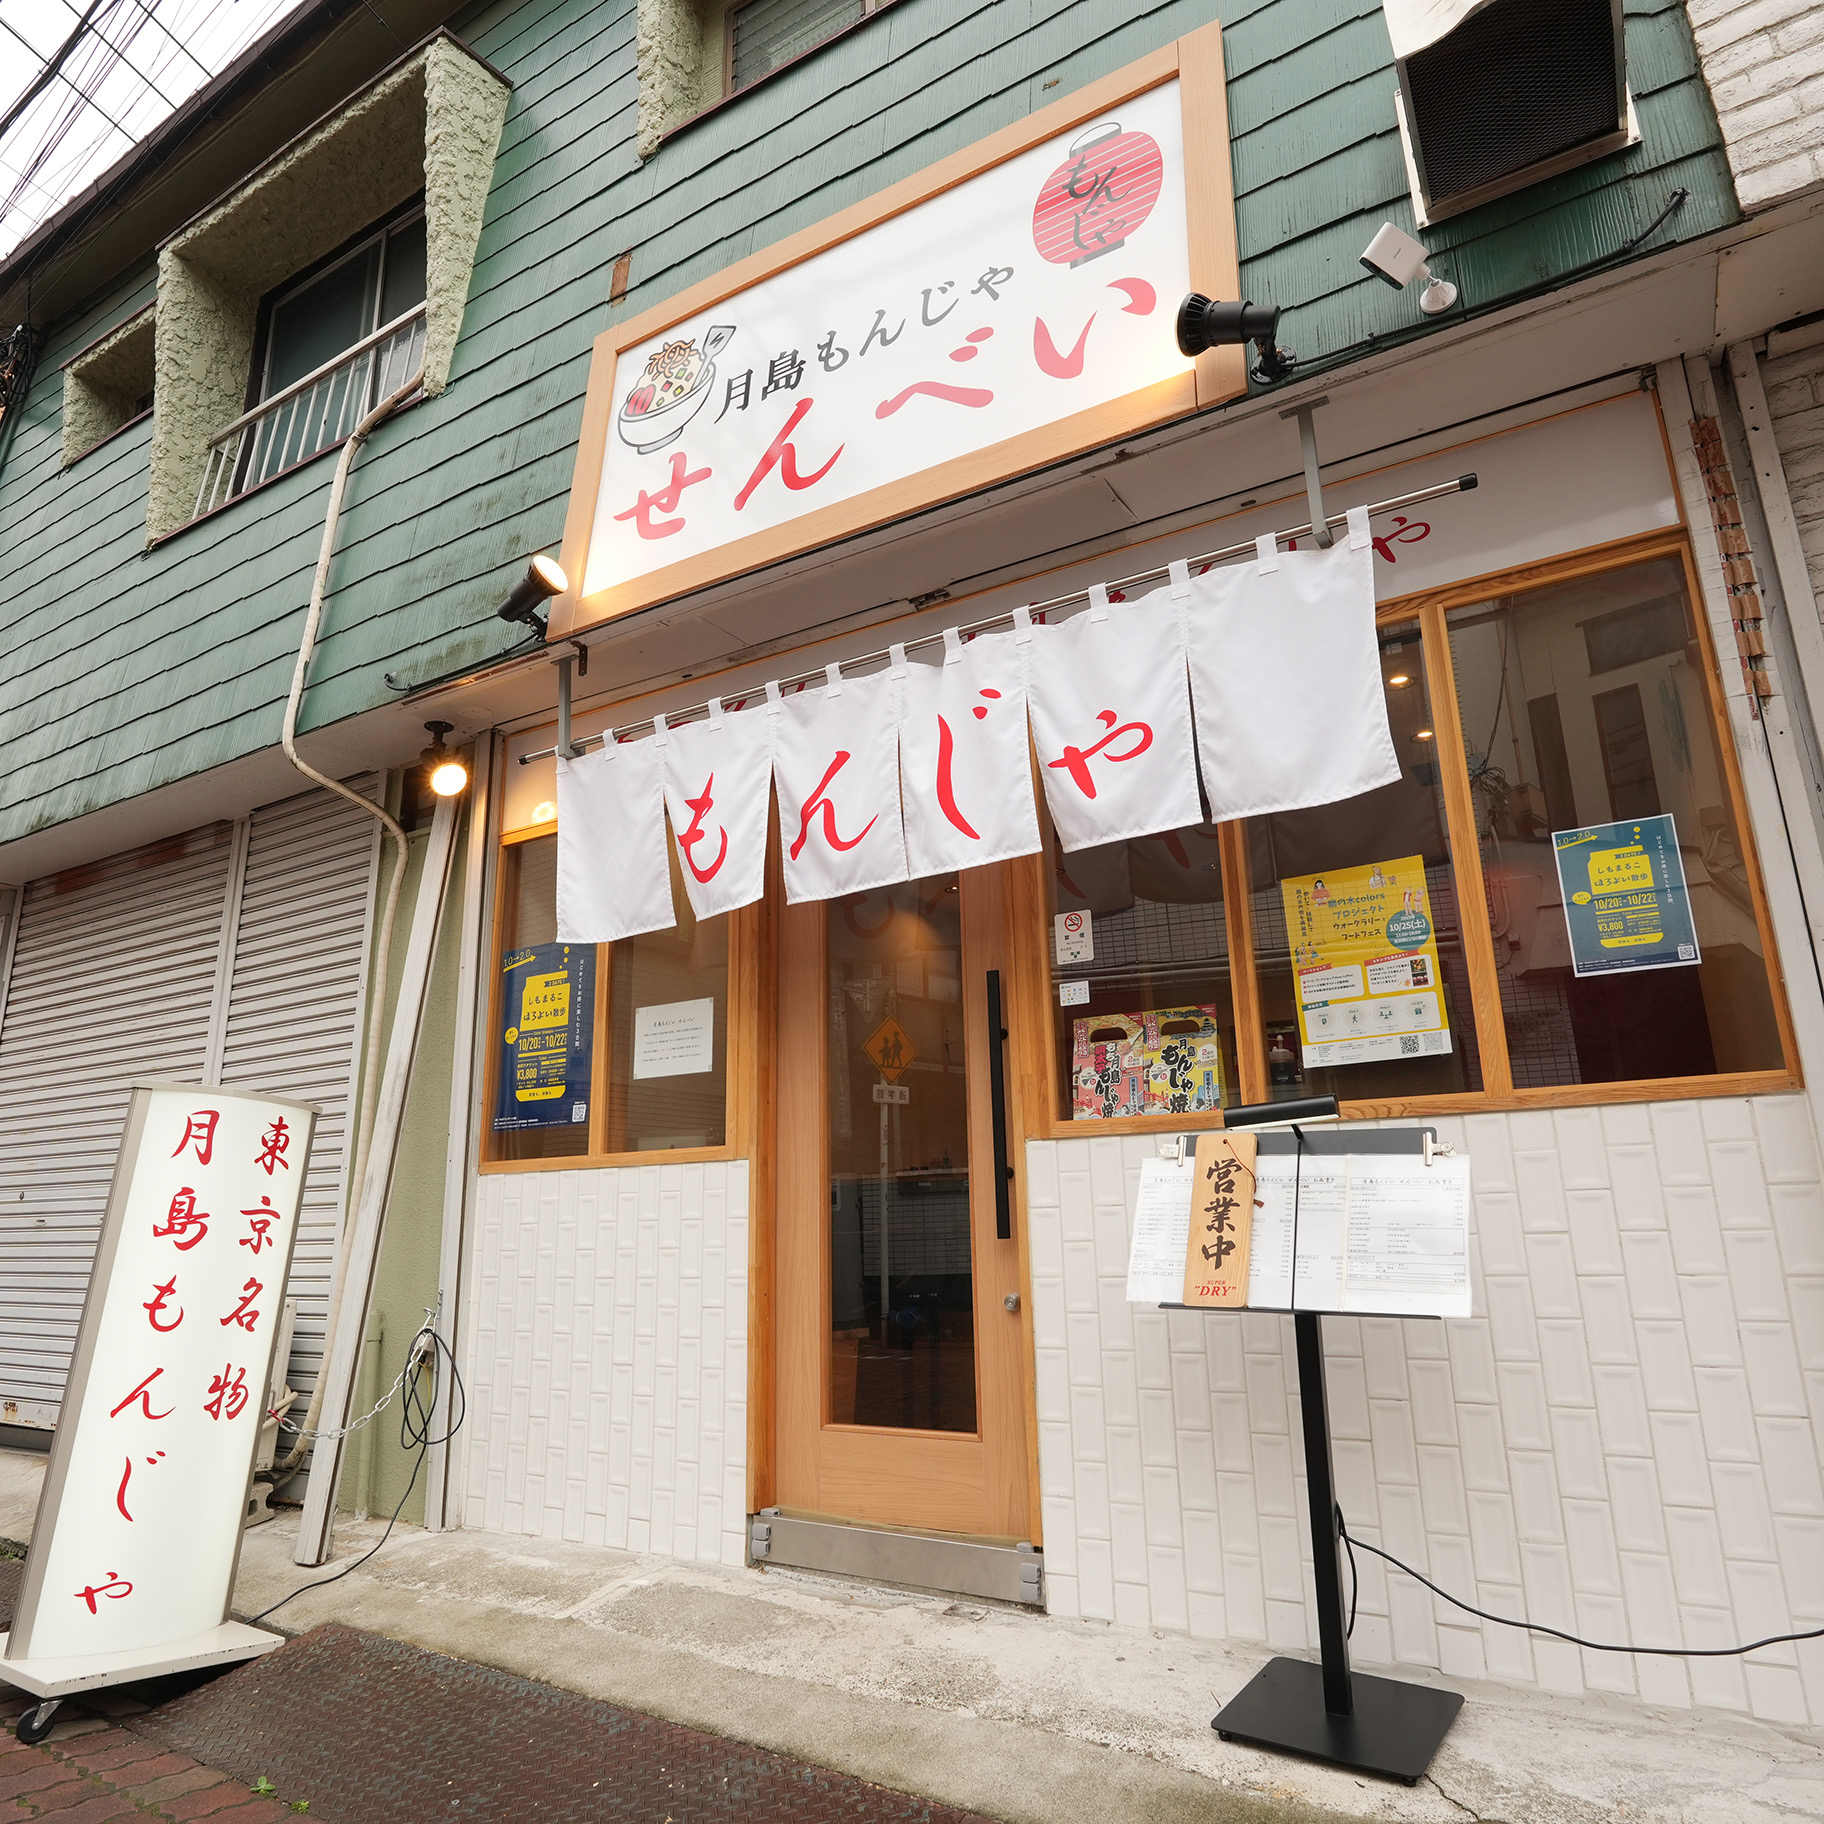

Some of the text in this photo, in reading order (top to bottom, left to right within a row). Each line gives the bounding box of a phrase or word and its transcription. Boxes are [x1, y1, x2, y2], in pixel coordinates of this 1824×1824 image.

[1062, 154, 1134, 250] もんじゃ
[714, 265, 1014, 424] 月島もんじゃ
[613, 277, 1157, 540] せんべい
[677, 689, 1154, 884] もんじゃ
[1597, 862, 1641, 875] しもまるこ
[1595, 873, 1649, 887] ほろよい散歩
[1593, 897, 1619, 910] 10/20
[1627, 892, 1653, 906] 10/22
[1333, 904, 1385, 920] プロジェクト
[1341, 928, 1382, 940] フードフェス
[1389, 918, 1426, 933] 10/25(土)
[1597, 920, 1624, 932] ¥3,800
[528, 992, 562, 1006] しもまるこ
[523, 1007, 566, 1022] ほろよい散歩
[518, 1037, 538, 1052] 10/20
[545, 1033, 566, 1048] 10/22
[516, 1068, 538, 1080] ¥3,800
[1201, 1158, 1242, 1271] 営業中
[203, 1116, 290, 1423] 東京名物
[74, 1110, 220, 1615] 月島もんじゃ
